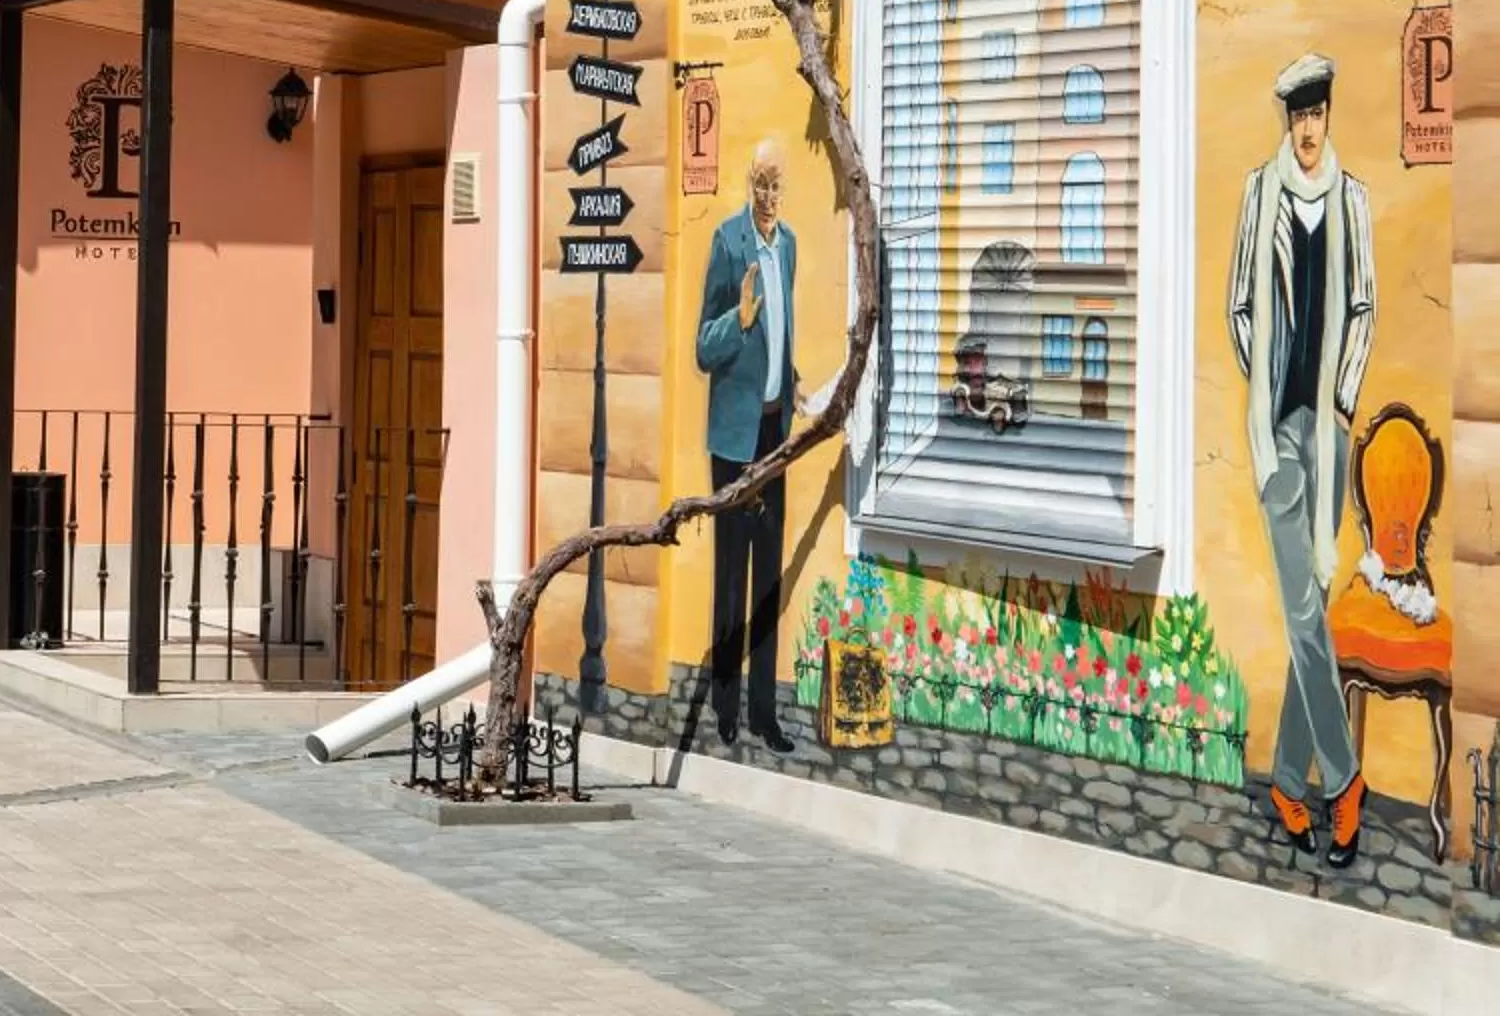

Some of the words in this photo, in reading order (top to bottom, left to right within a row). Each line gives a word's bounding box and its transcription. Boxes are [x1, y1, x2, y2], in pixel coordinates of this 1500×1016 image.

[578, 131, 613, 168] ПРИВОЗ
[579, 194, 621, 217] АРКАДИЯ
[50, 208, 181, 236] Potemkn
[75, 246, 138, 261] HOTE
[567, 243, 627, 265] ПУШКИНСКАЯ
